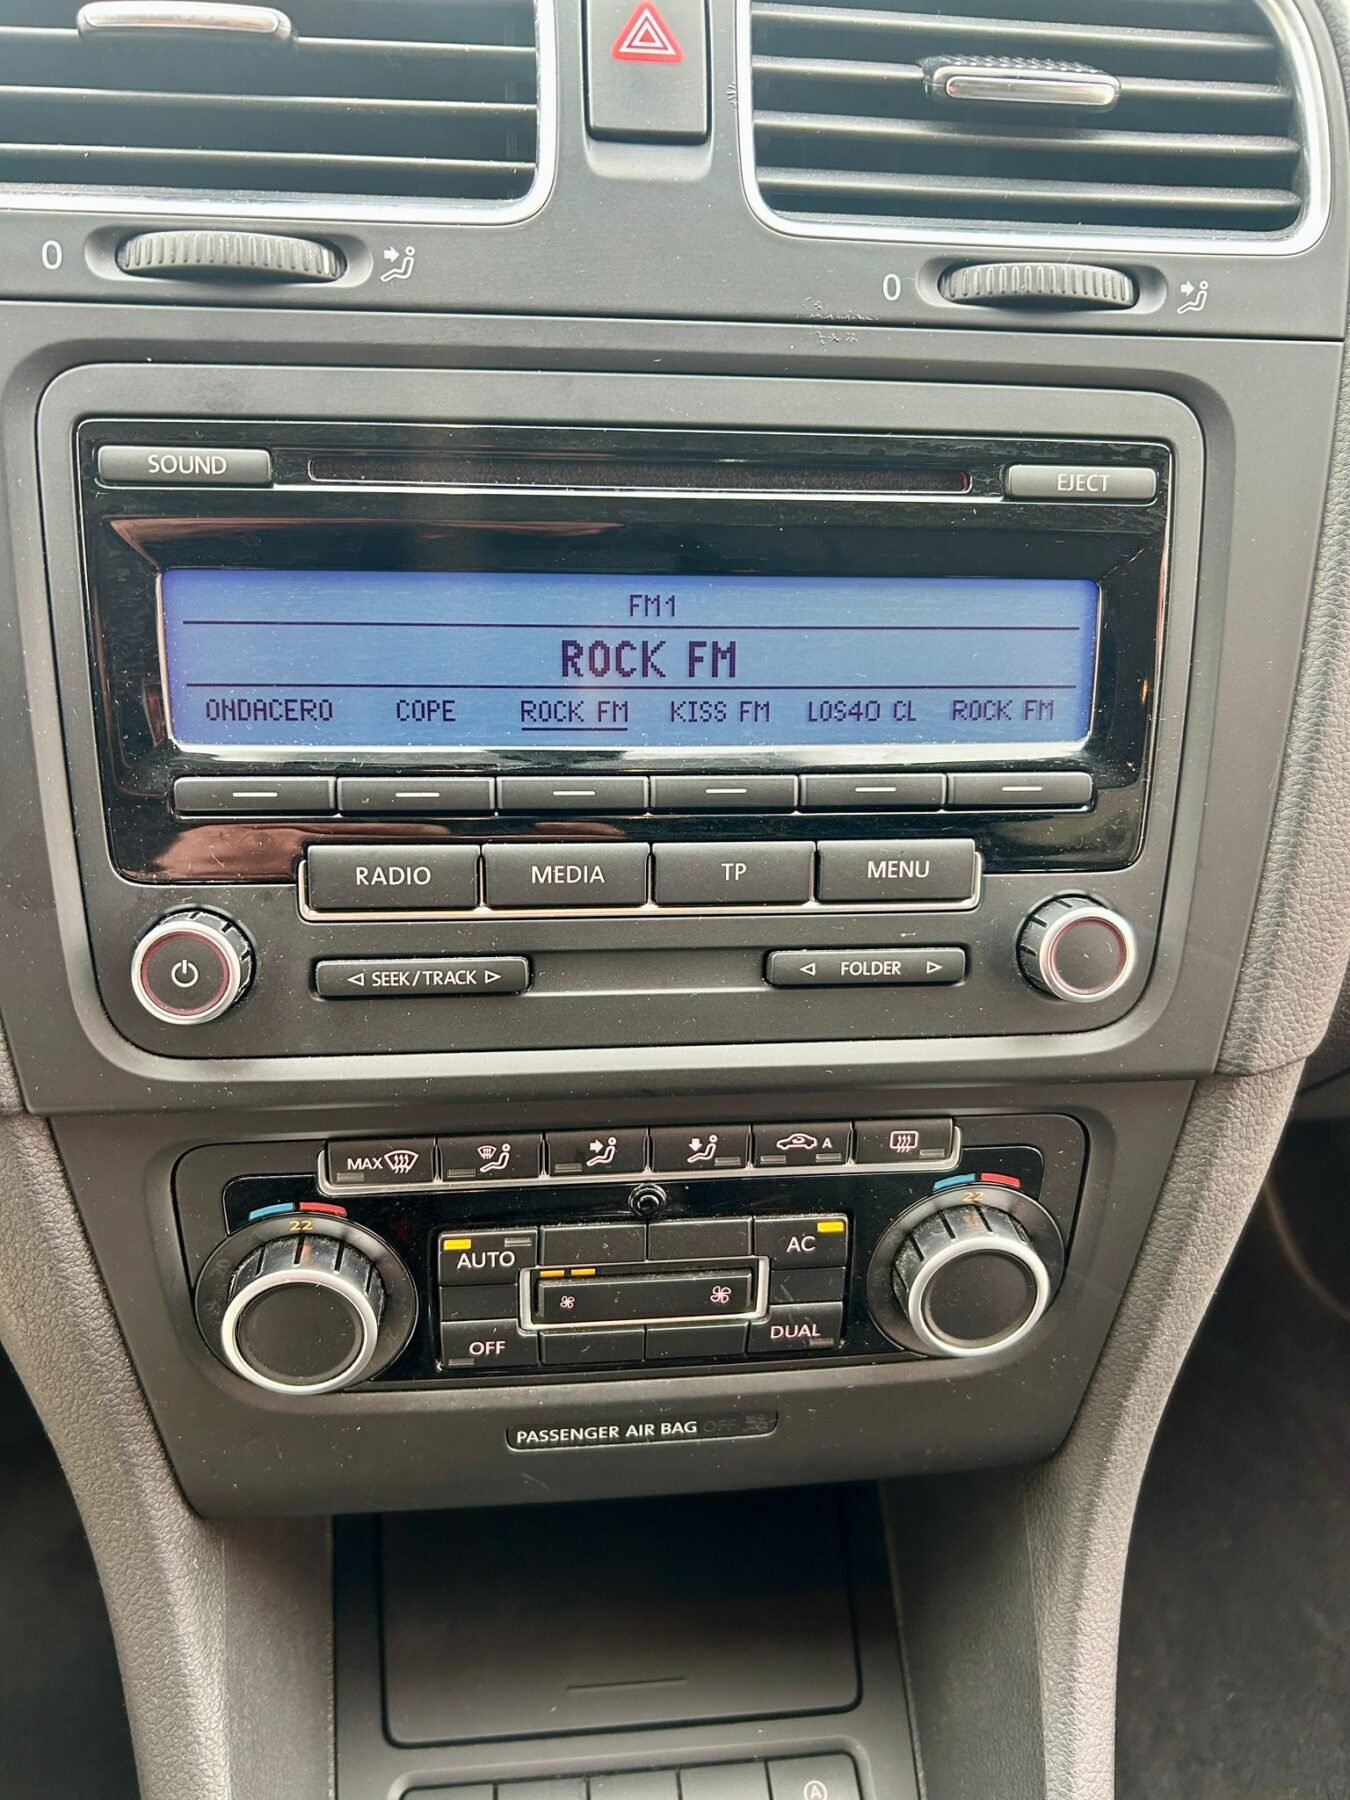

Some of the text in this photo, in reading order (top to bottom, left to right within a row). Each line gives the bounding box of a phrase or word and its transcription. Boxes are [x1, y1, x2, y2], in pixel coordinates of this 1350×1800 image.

[42, 240, 62, 270] 0
[883, 273, 900, 301] 0
[147, 454, 227, 475] SOUND
[1057, 473, 1110, 492] EJECT
[629, 595, 676, 616] FM1
[561, 640, 736, 678] ROCK FM
[206, 699, 333, 721] ONDACERO
[396, 700, 456, 722] COPE
[520, 701, 629, 722] ROCK FM
[670, 701, 770, 722] KISS FM
[892, 701, 917, 722] CL
[952, 700, 1054, 722] ROCK FM
[355, 866, 432, 887] RADIO
[531, 864, 605, 884] MEDIA
[722, 862, 747, 881] TP
[866, 860, 930, 880] MENU
[840, 961, 902, 976] FOLDER
[371, 970, 477, 988] SEEK/TRACK
[822, 1137, 832, 1150] A
[347, 1156, 383, 1171] MAX
[963, 1191, 985, 1203] 22
[289, 1220, 313, 1231] 22
[786, 1236, 816, 1253] AC
[456, 1251, 516, 1269] AUTO
[770, 1323, 821, 1339] DUAL
[469, 1340, 506, 1356] OFF
[516, 1426, 620, 1443] PASSENGER
[625, 1423, 655, 1437] AIR
[660, 1421, 697, 1435] BAG
